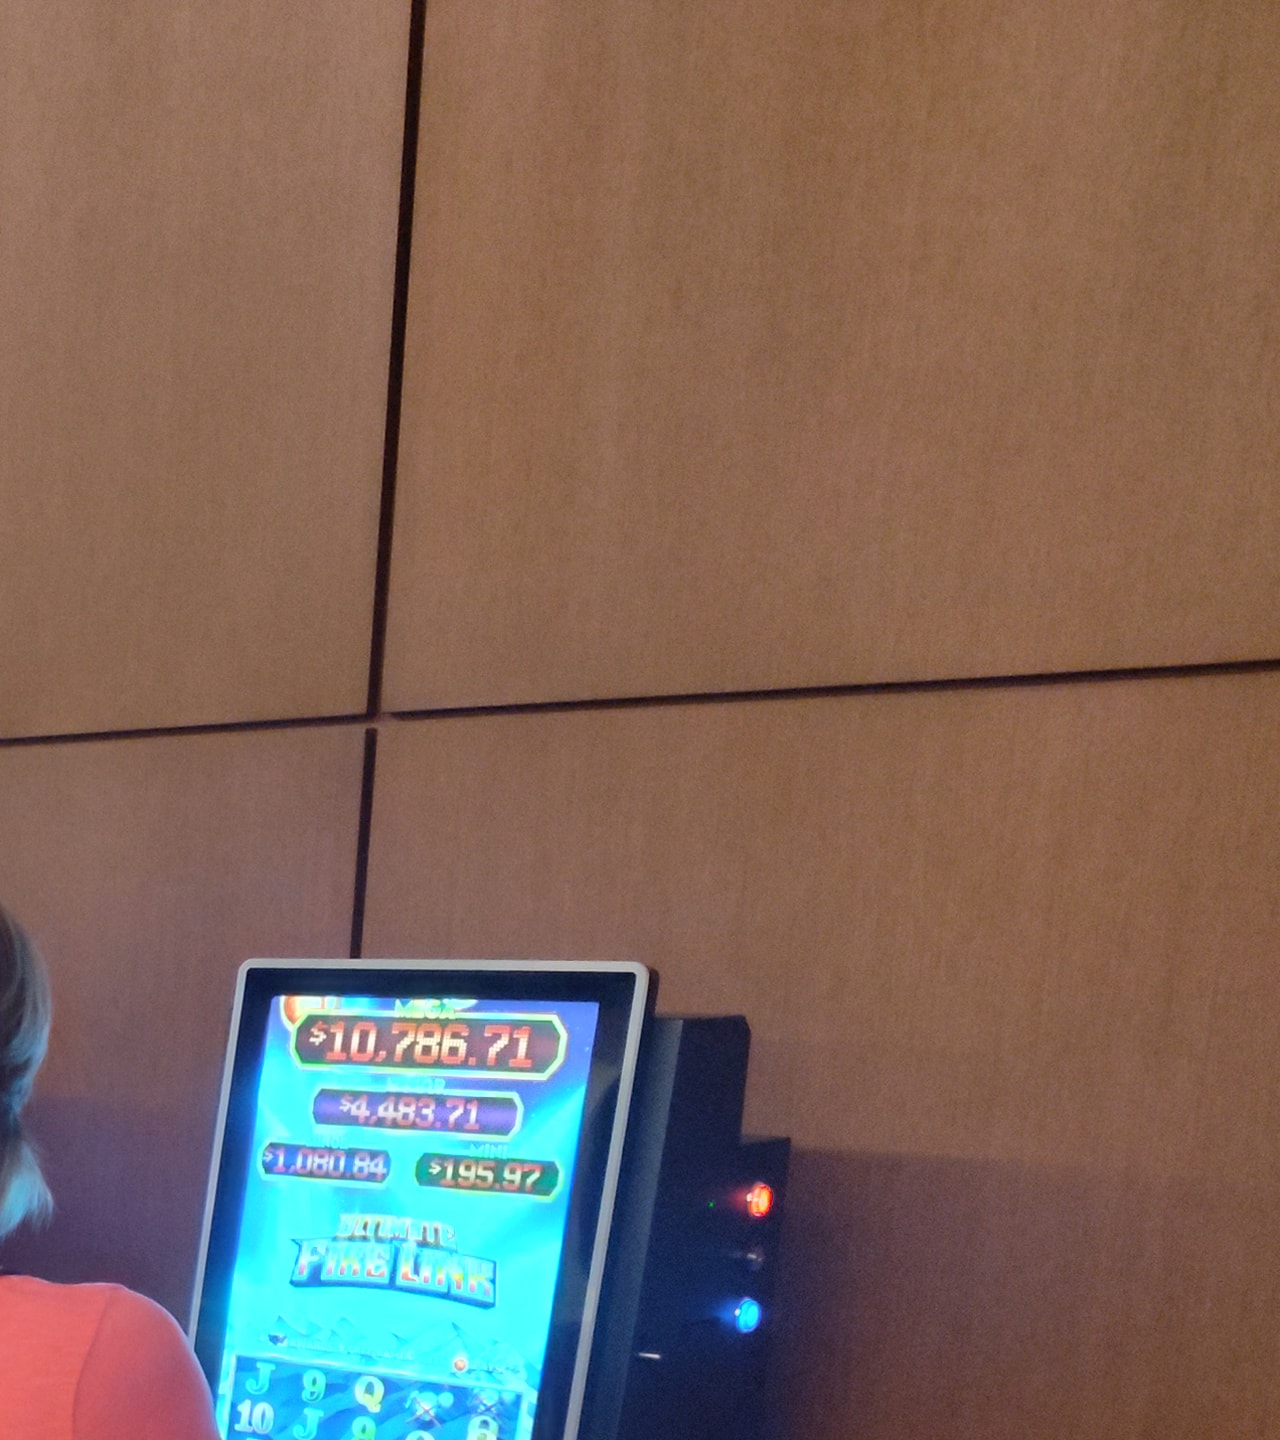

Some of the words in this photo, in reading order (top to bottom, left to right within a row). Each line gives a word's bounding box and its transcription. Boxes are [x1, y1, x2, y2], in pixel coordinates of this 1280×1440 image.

[309, 1021, 533, 1068] $10,786.71
[339, 1094, 481, 1131] $4,483.71
[429, 1158, 542, 1193] $195.97
[394, 1241, 494, 1300] LINK
[246, 1362, 275, 1394] J
[301, 1369, 326, 1403] 9
[355, 1375, 385, 1412] Q
[234, 1399, 274, 1434] 10
[293, 1408, 324, 1440] J
